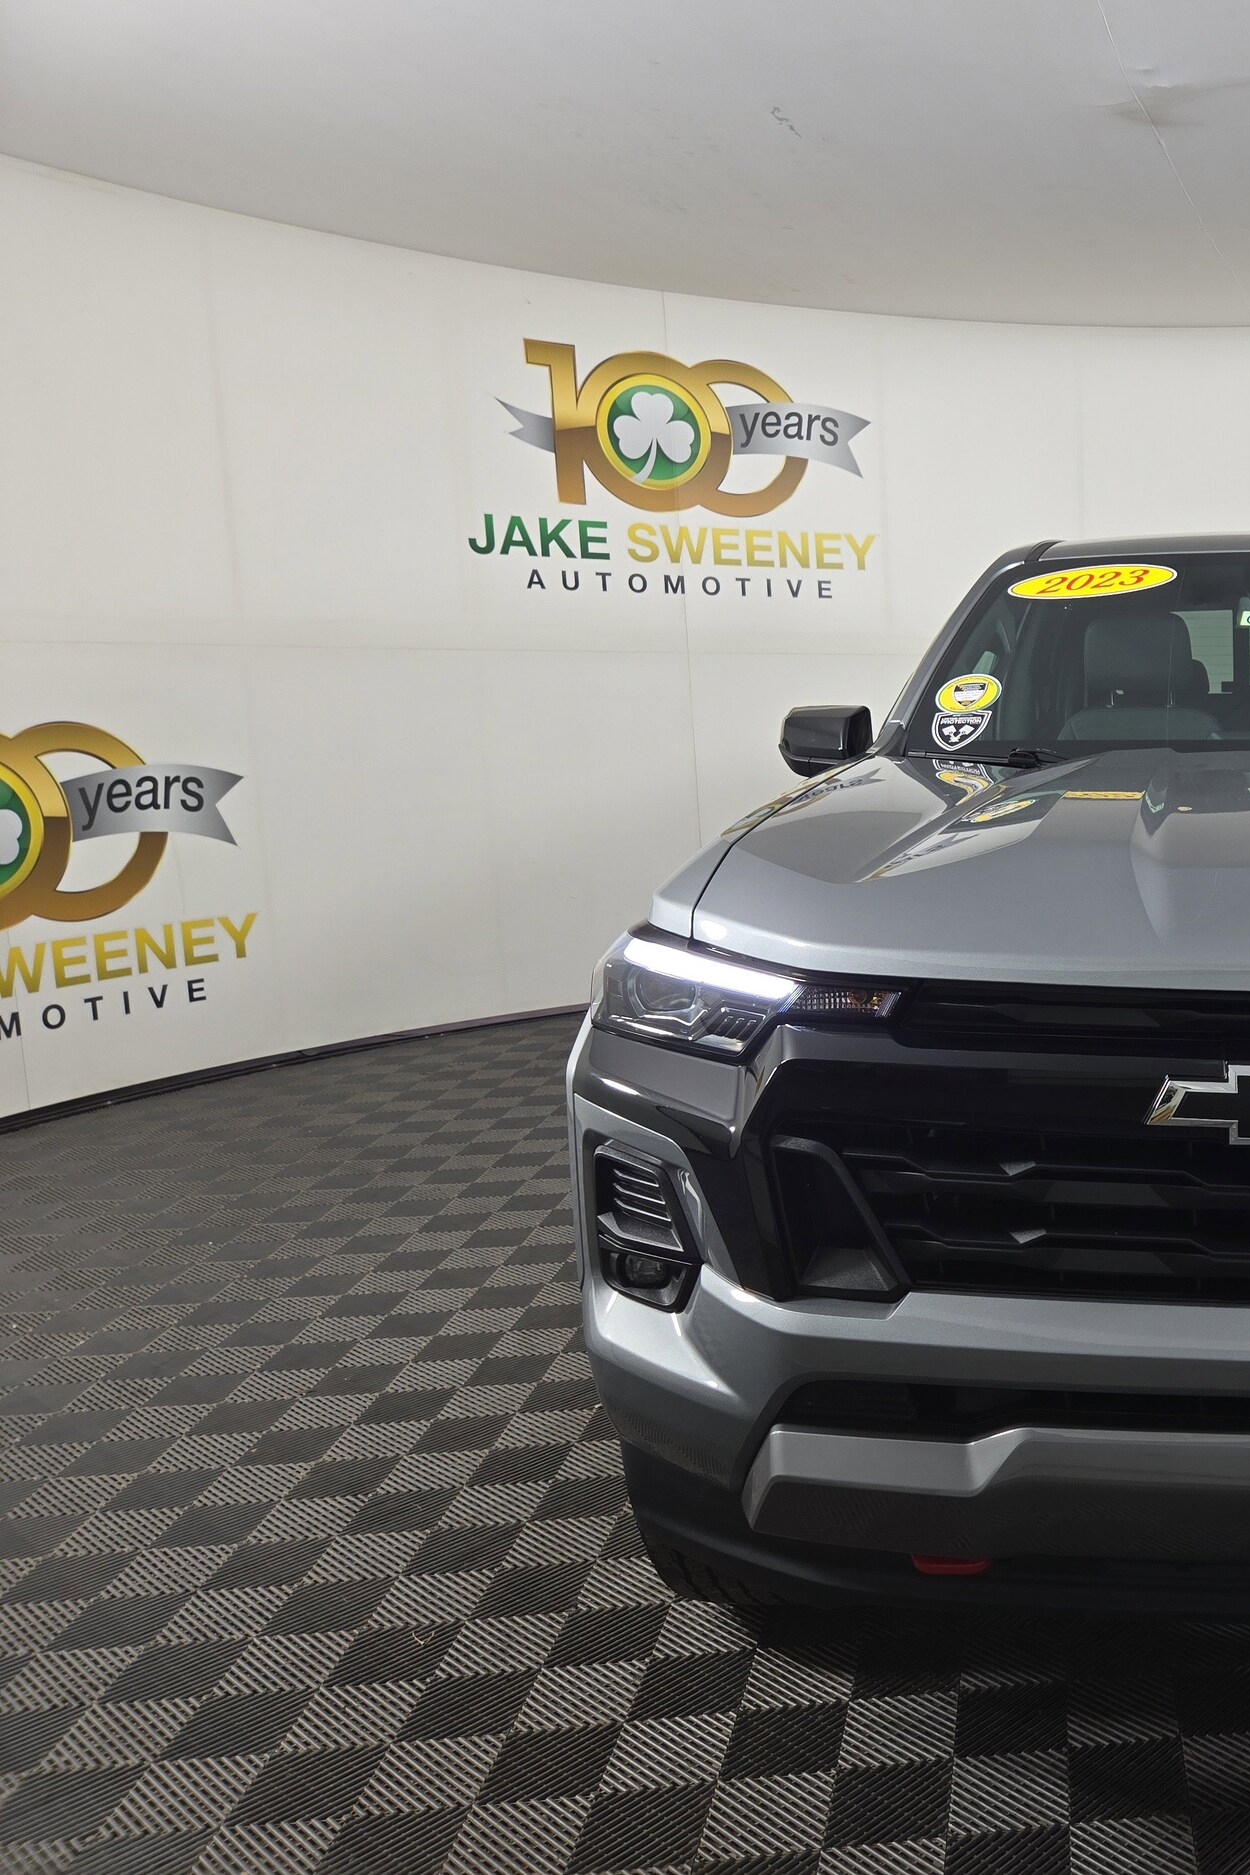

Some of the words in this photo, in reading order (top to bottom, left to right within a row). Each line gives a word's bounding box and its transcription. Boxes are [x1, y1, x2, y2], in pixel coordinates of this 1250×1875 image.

[739, 411, 839, 448] years
[468, 514, 611, 560] JAKE
[627, 523, 875, 570] SWEENEY
[526, 568, 833, 600] AUTOMOTIVE
[1036, 569, 1150, 595] 2023
[78, 775, 205, 831] years
[0, 913, 258, 998] WEENEY
[0, 978, 207, 1041] MOTIVE
